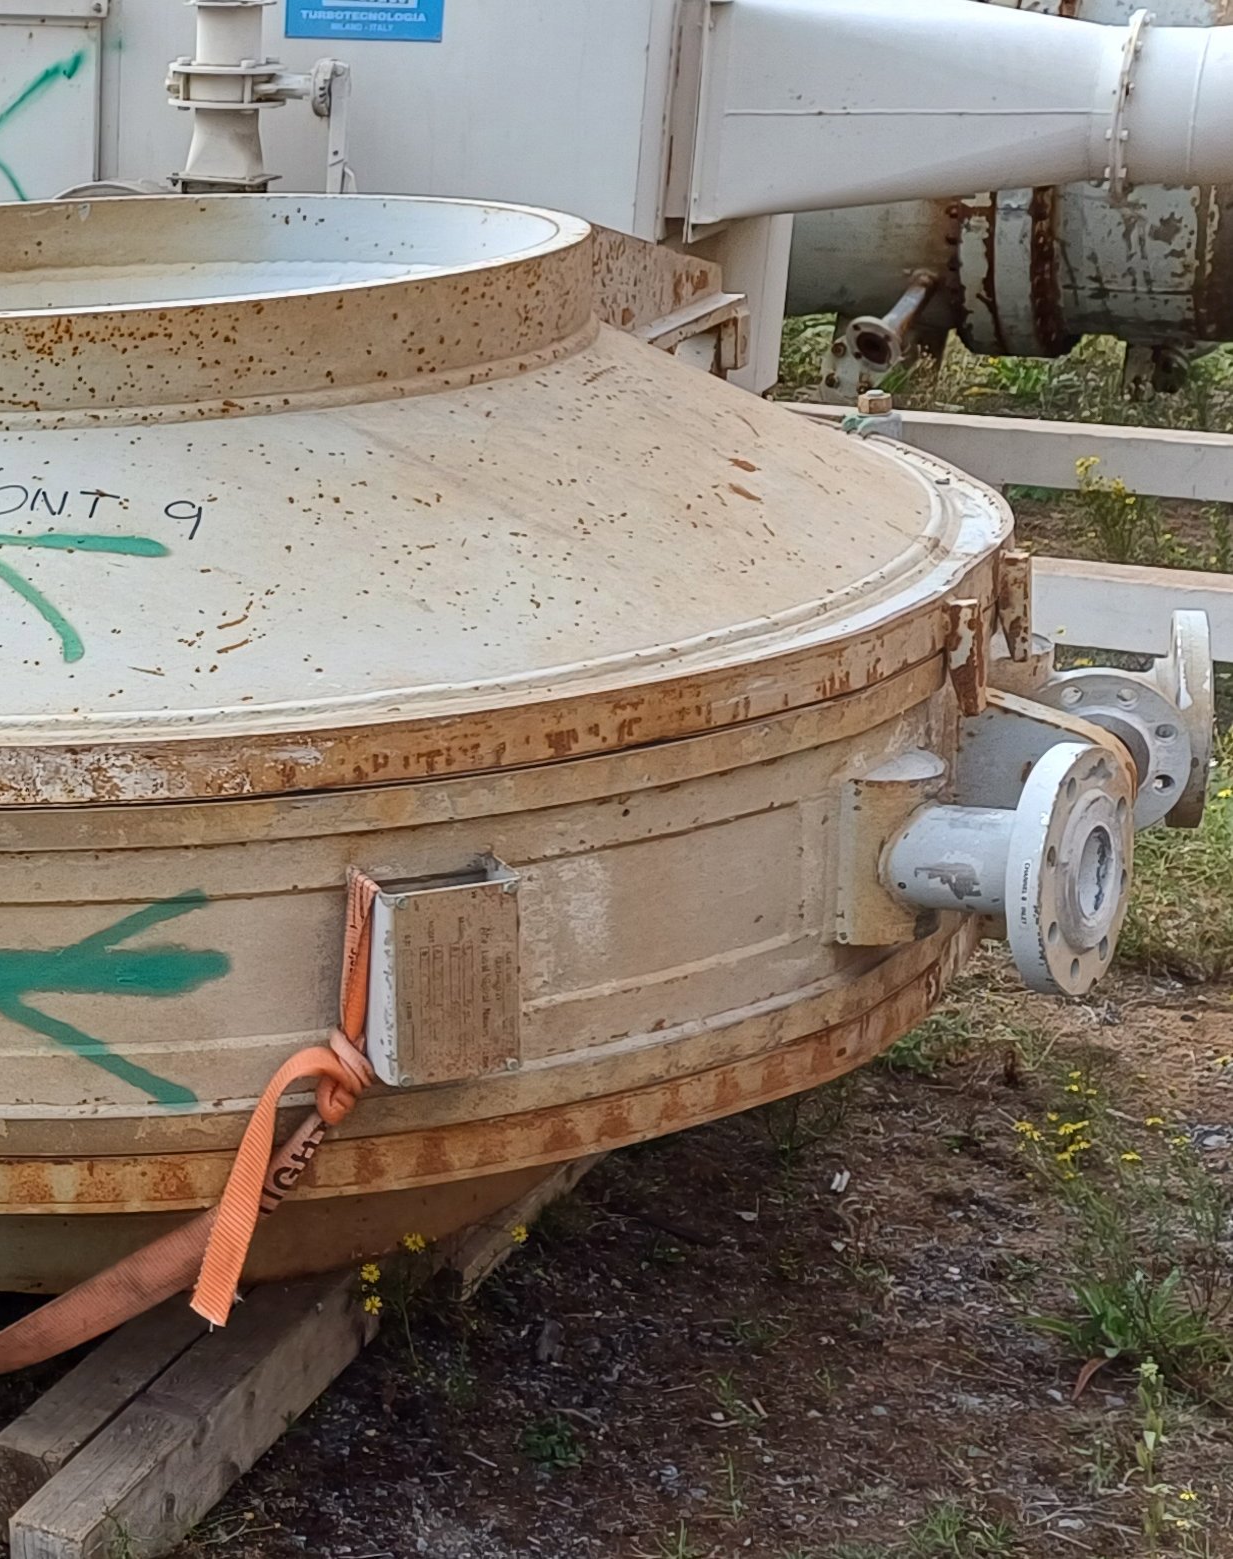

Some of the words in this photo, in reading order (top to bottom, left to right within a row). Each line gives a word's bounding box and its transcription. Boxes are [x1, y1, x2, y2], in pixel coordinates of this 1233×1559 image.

[301, 10, 426, 22] TURBOTECNOLOGIA
[369, 23, 394, 32] ITALY
[164, 500, 202, 540] 9
